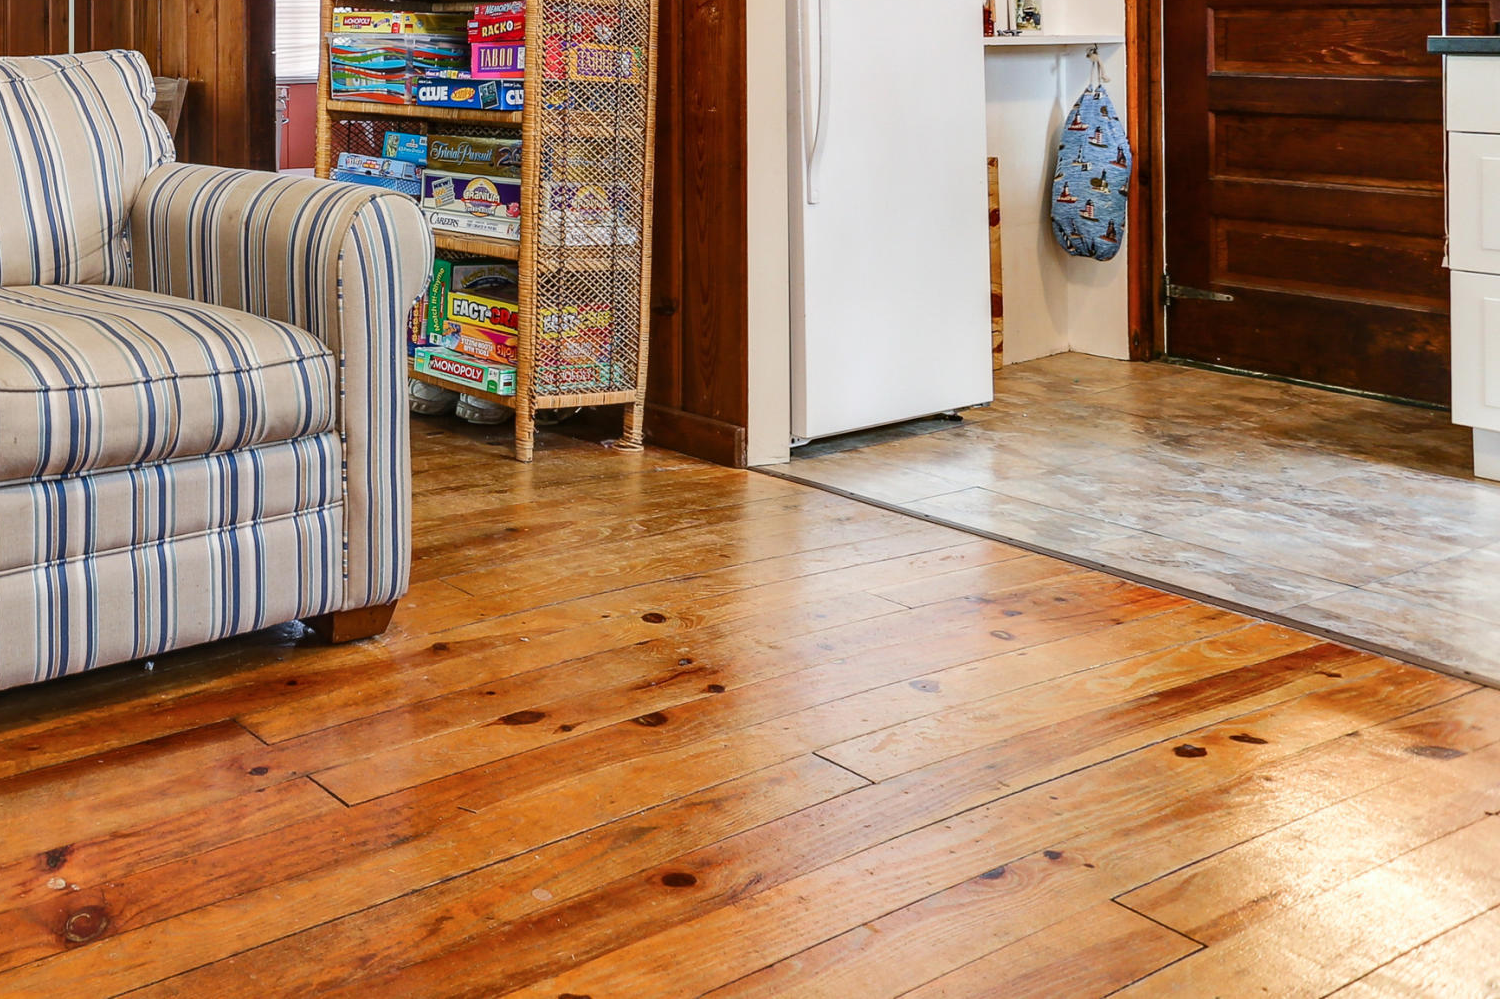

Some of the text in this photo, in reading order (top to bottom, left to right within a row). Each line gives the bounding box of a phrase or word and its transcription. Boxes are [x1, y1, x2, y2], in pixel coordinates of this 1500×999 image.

[480, 48, 513, 67] TABOO
[418, 86, 448, 101] CLUE
[430, 140, 493, 166] Trivial Pursuit
[429, 211, 460, 228] CAREERS
[453, 299, 487, 322] FACT
[490, 307, 518, 329] CRA
[432, 359, 482, 379] MONOPOLY
